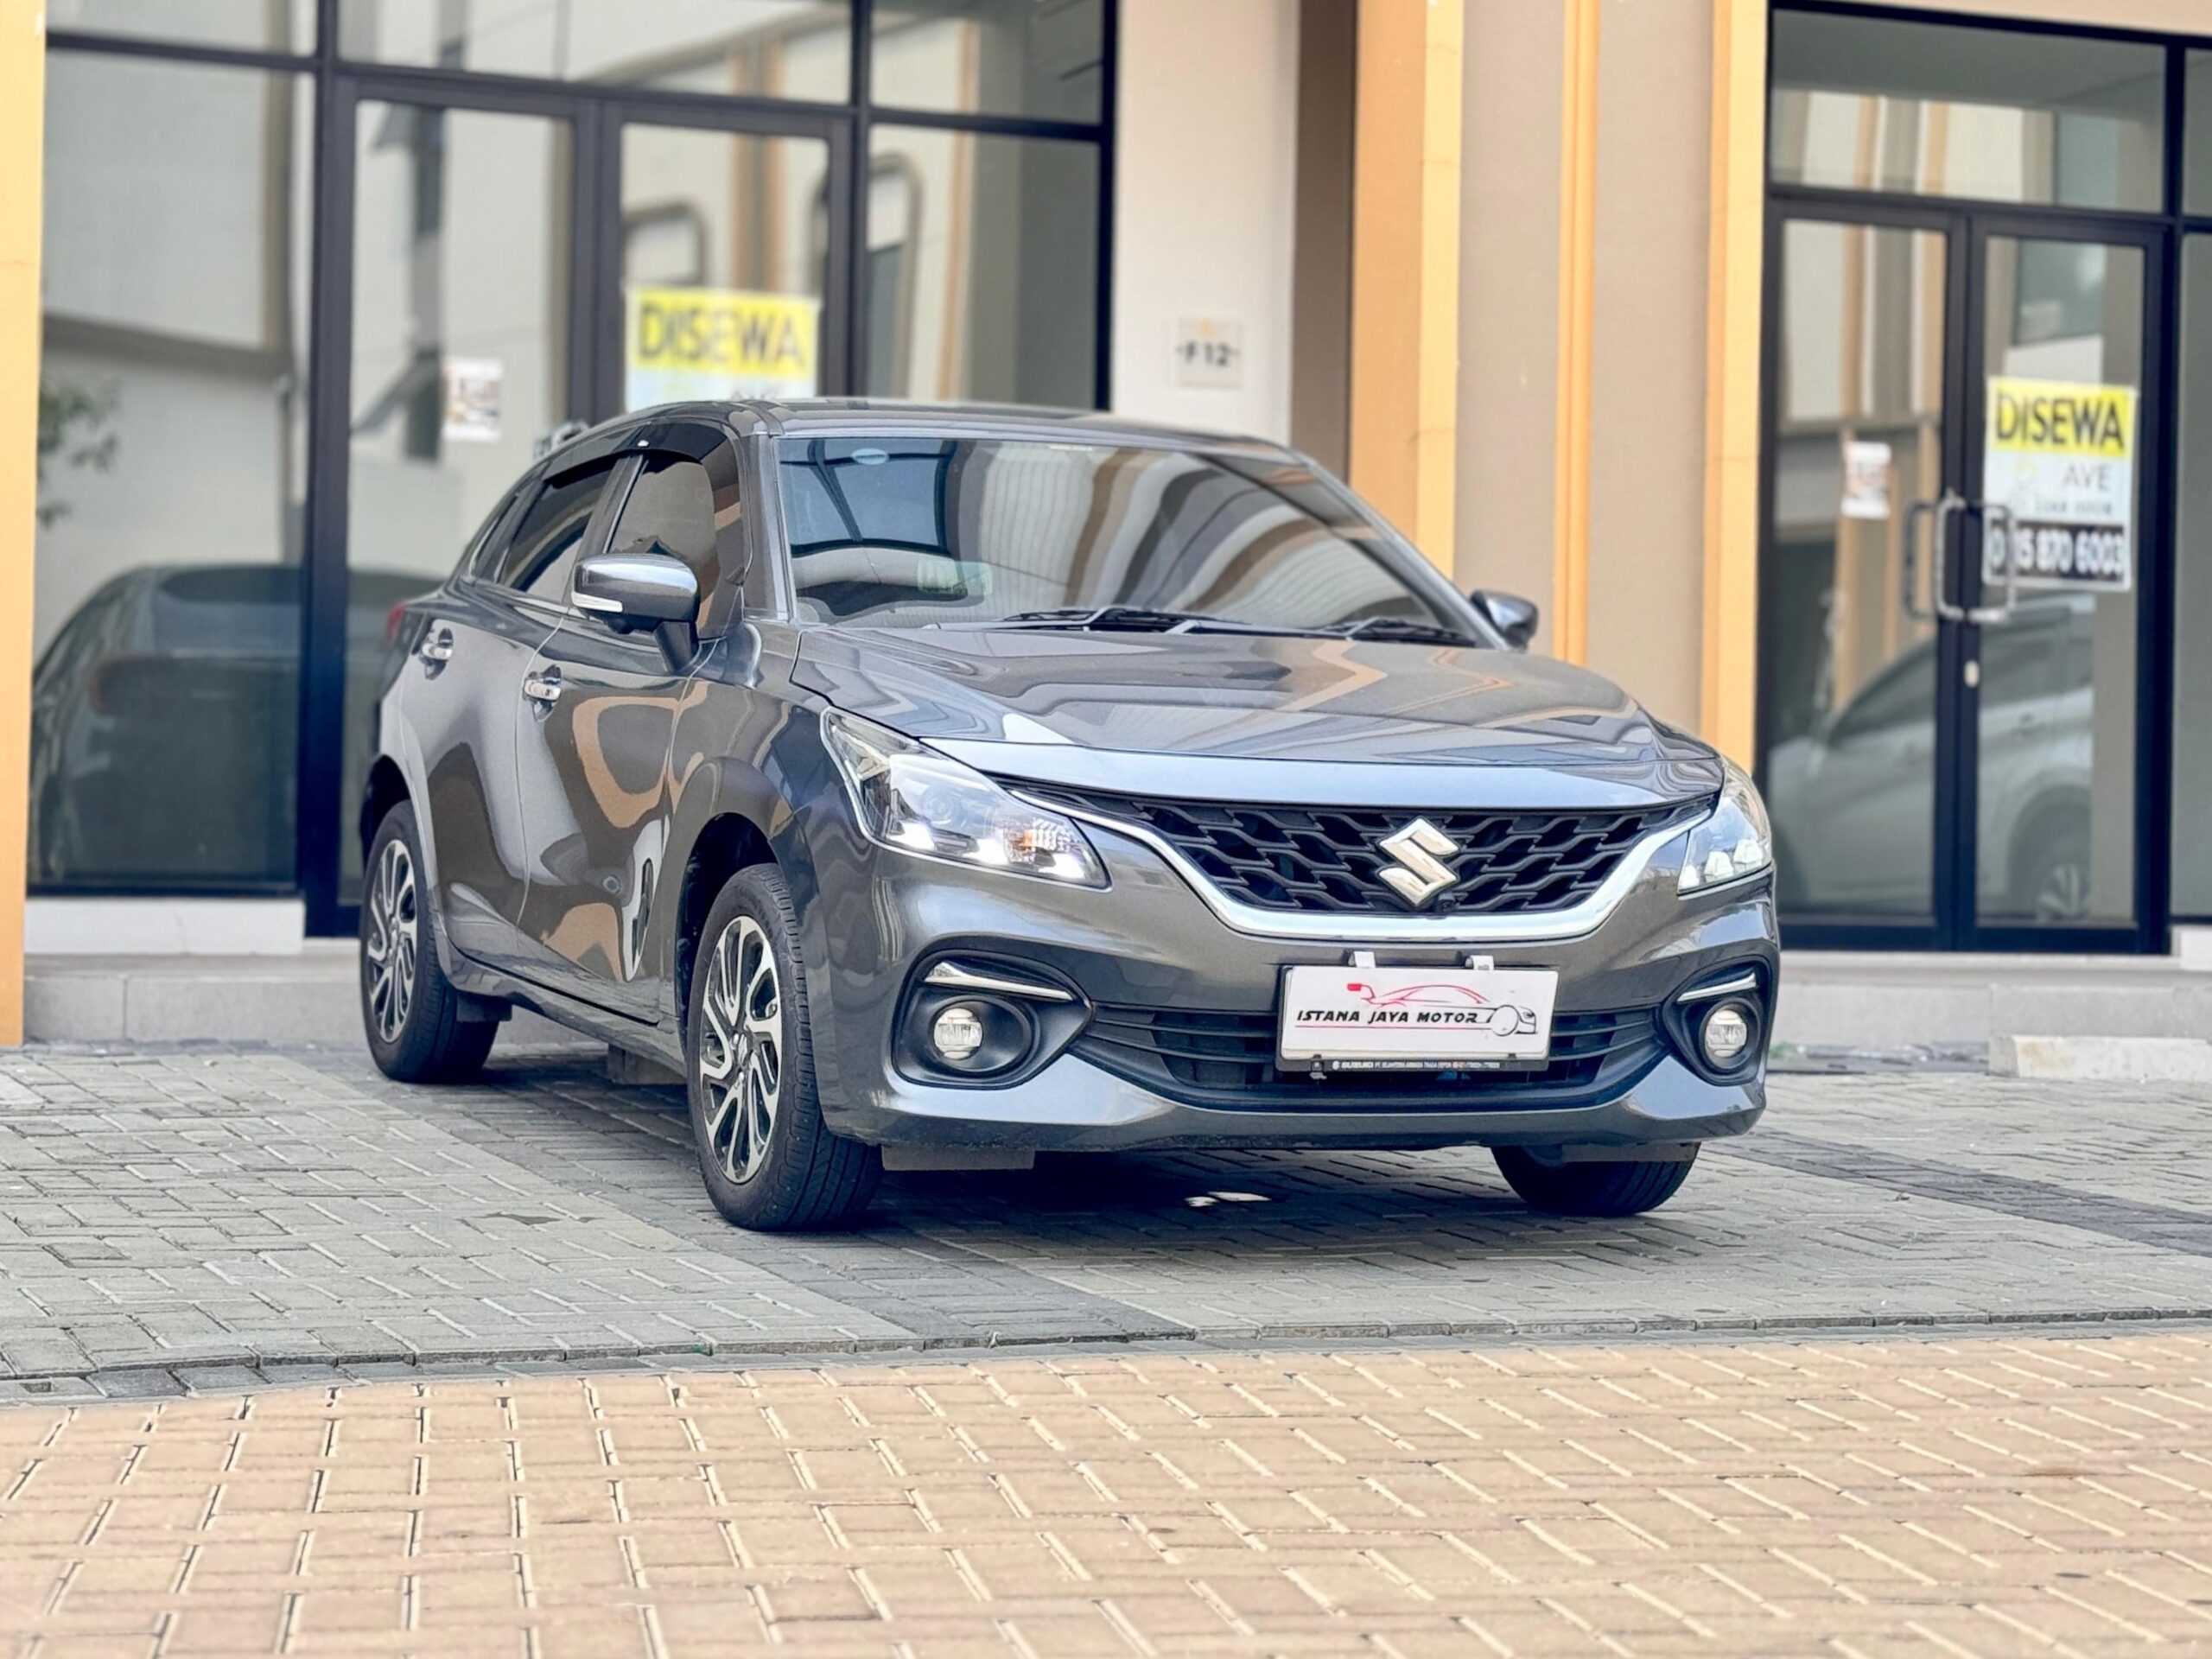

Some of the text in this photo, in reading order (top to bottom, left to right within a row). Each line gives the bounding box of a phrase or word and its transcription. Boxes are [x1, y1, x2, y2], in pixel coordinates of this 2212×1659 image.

[639, 303, 807, 368] DISEWA
[1995, 391, 2126, 449] DISEWA
[2062, 462, 2113, 492] AVE
[1296, 1009, 1478, 1024] ISTANA JAYA MOTOR
